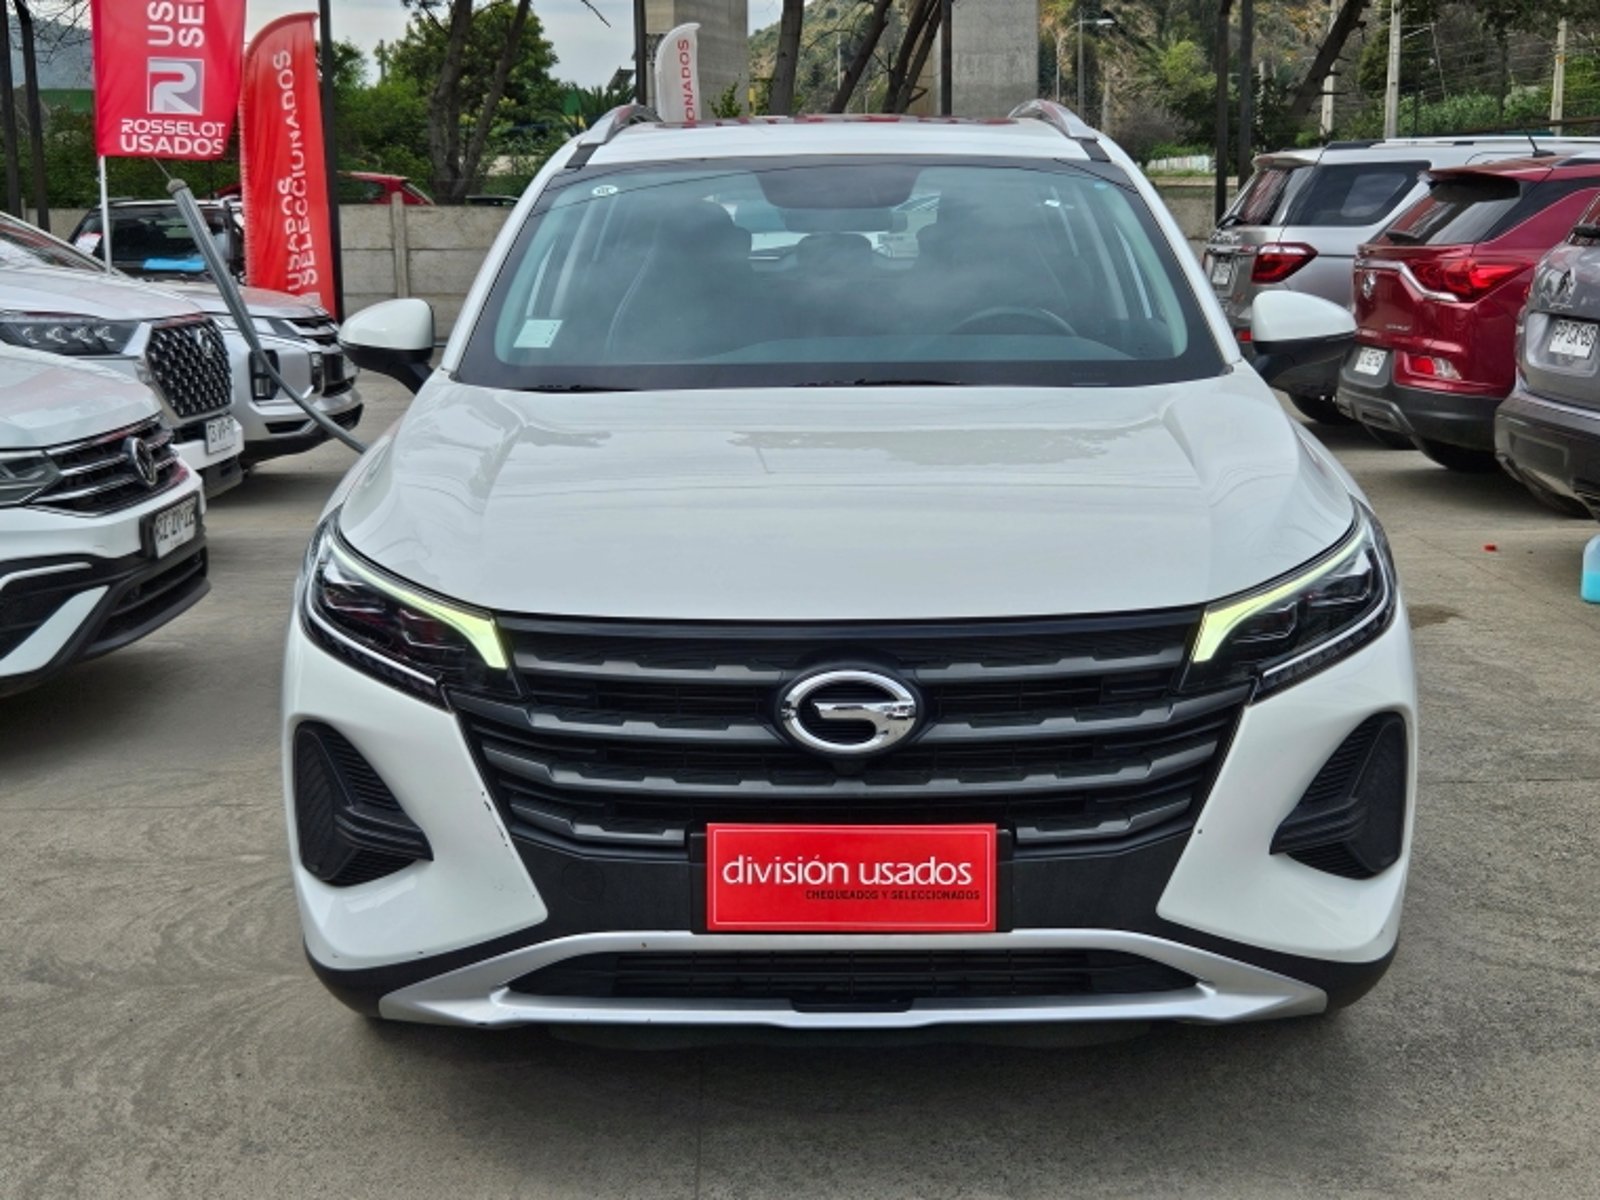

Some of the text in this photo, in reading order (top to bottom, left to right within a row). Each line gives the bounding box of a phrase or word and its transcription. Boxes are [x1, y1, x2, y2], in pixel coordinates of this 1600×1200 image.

[178, 0, 205, 48] SE
[121, 118, 226, 138] ROSSELOT
[119, 134, 225, 156] USADOS
[721, 853, 973, 886] división usados
[805, 889, 981, 901] CHEQUEADOS Y SELECCIONADOS
